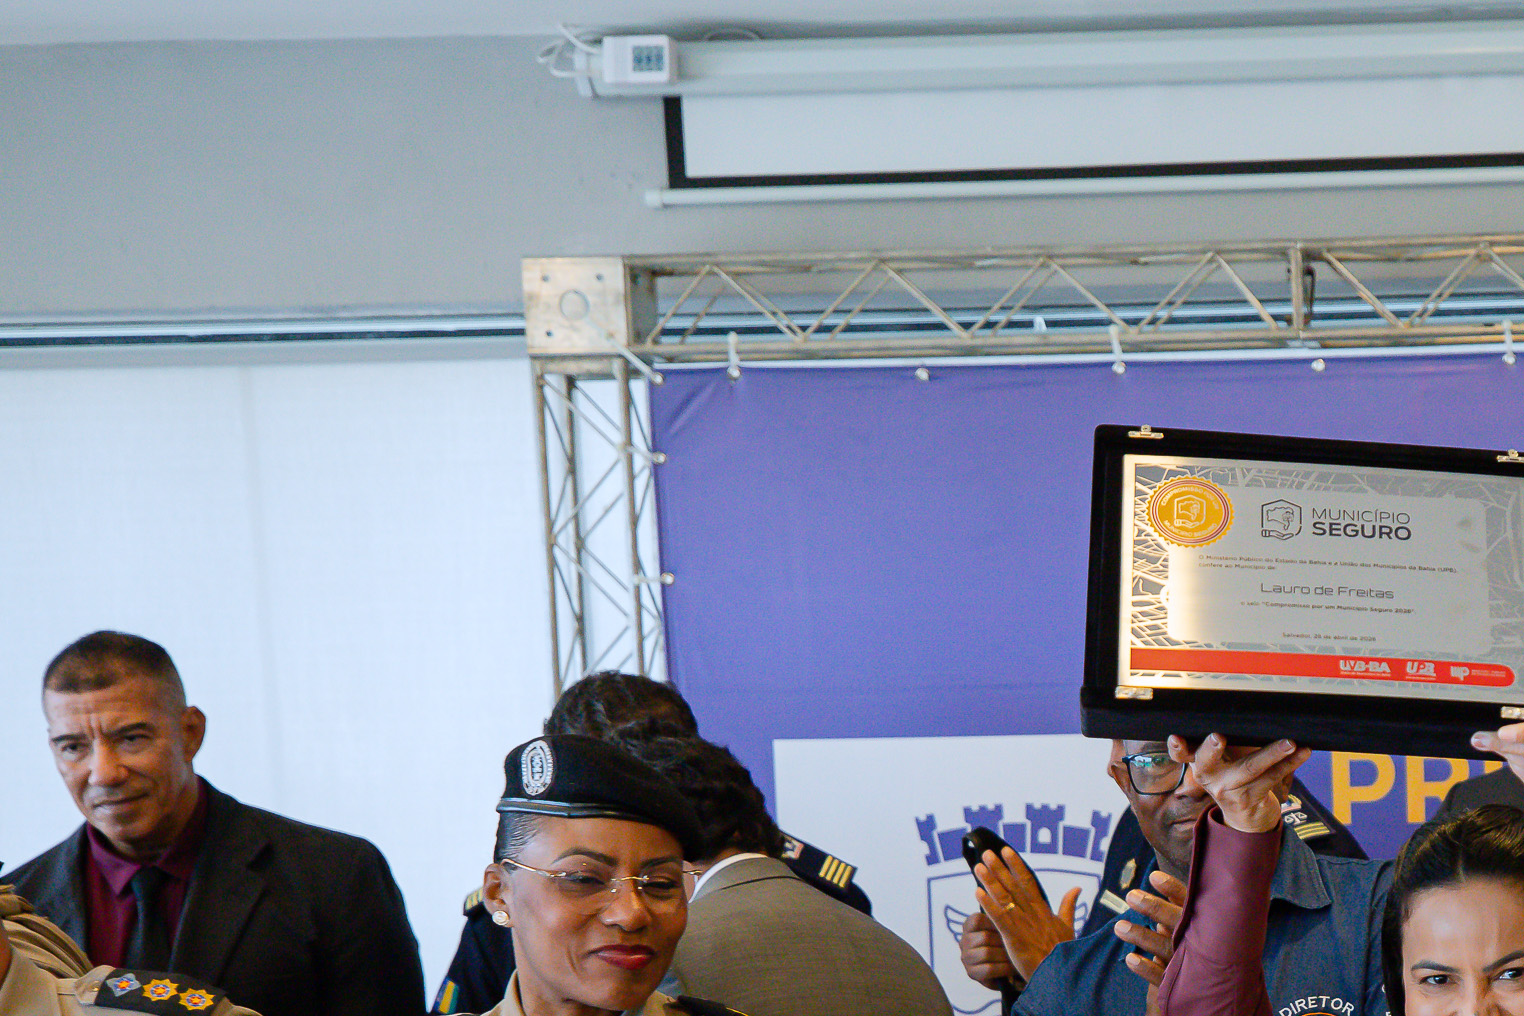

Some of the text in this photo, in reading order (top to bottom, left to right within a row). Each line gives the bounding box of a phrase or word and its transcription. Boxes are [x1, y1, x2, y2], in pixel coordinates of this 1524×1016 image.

[1312, 507, 1410, 525] MUNICÍPIO
[1312, 521, 1412, 541] SEGURO
[1260, 582, 1395, 600] Lauro de Freitas
